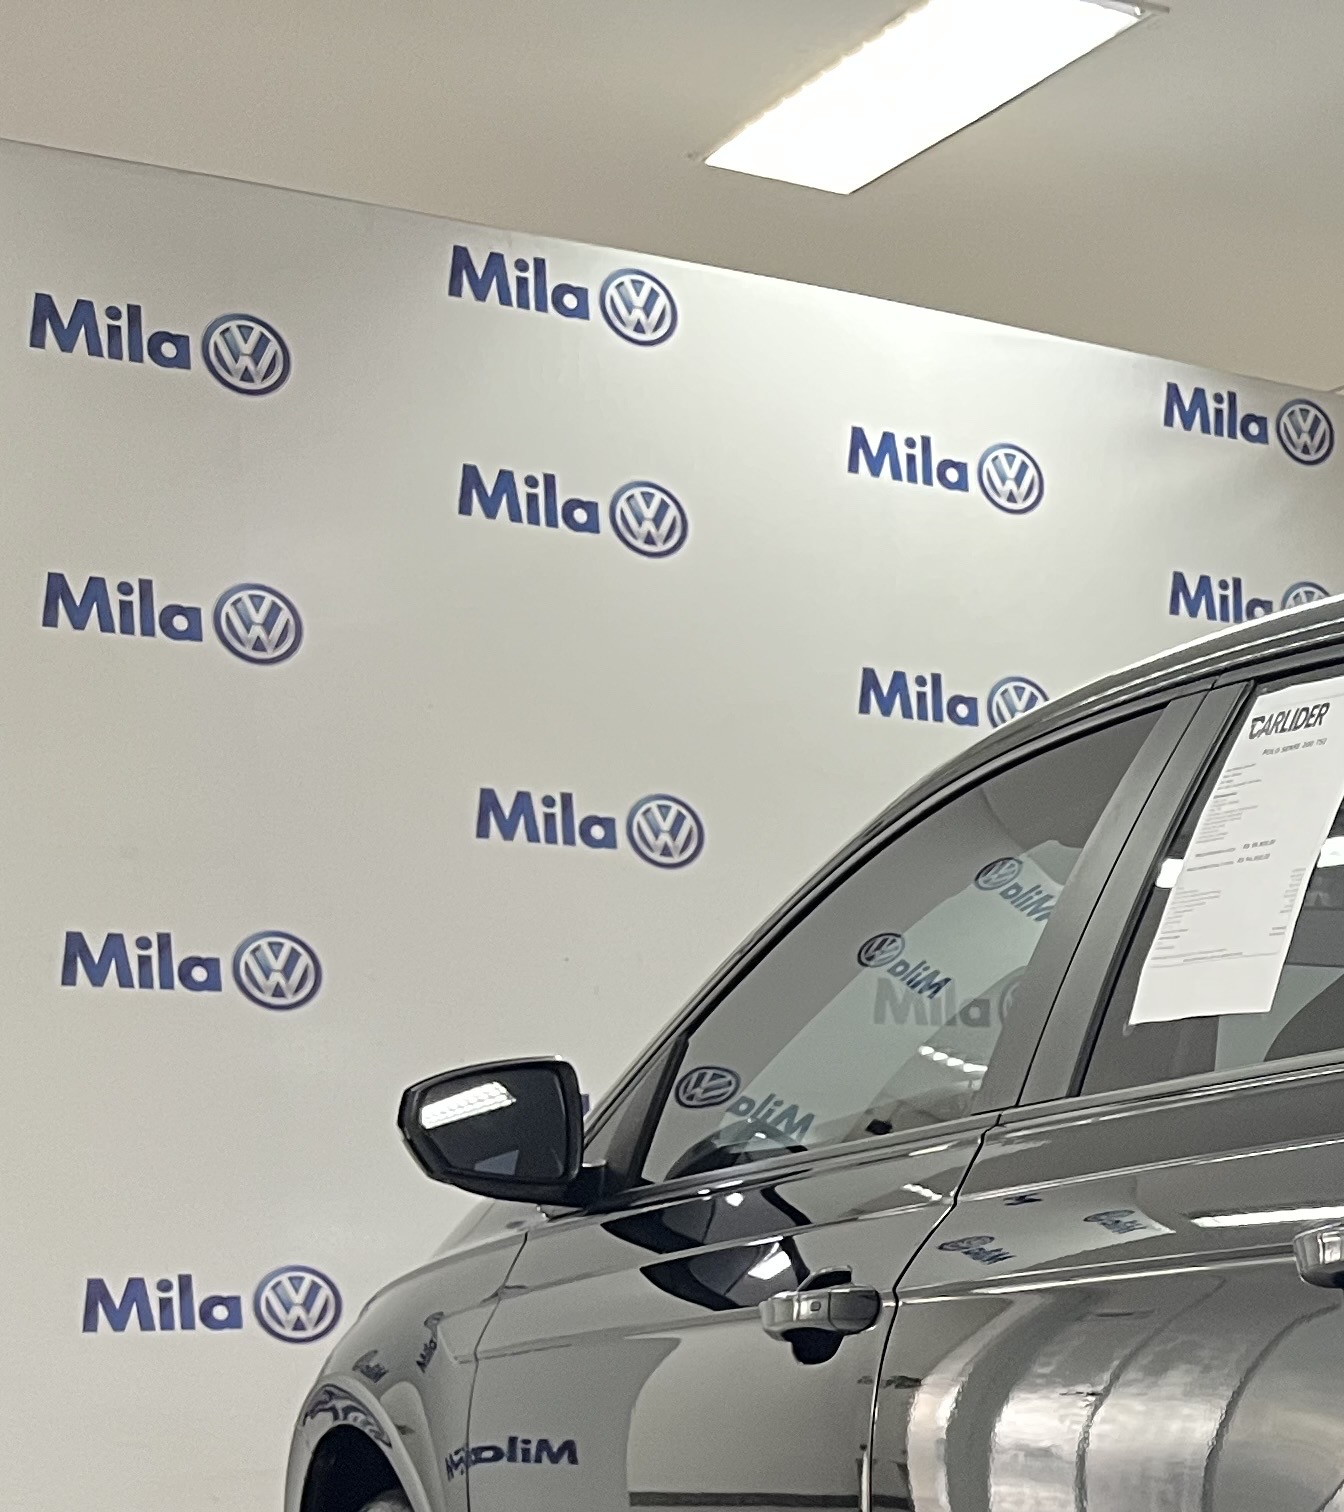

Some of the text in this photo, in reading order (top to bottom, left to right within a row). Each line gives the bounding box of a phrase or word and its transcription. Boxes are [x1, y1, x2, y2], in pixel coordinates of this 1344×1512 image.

[448, 245, 589, 320] Mila
[30, 293, 191, 370] Mila
[1164, 382, 1269, 445] Mila
[848, 427, 969, 492] Mila
[458, 464, 600, 534] Mila
[42, 572, 202, 642] Mila
[1170, 571, 1272, 624] Mila
[859, 667, 978, 726] Mila
[1249, 702, 1330, 740] CARLIDER
[476, 788, 617, 849] Mila
[61, 931, 222, 991] Mila
[83, 1274, 242, 1333] Mila
